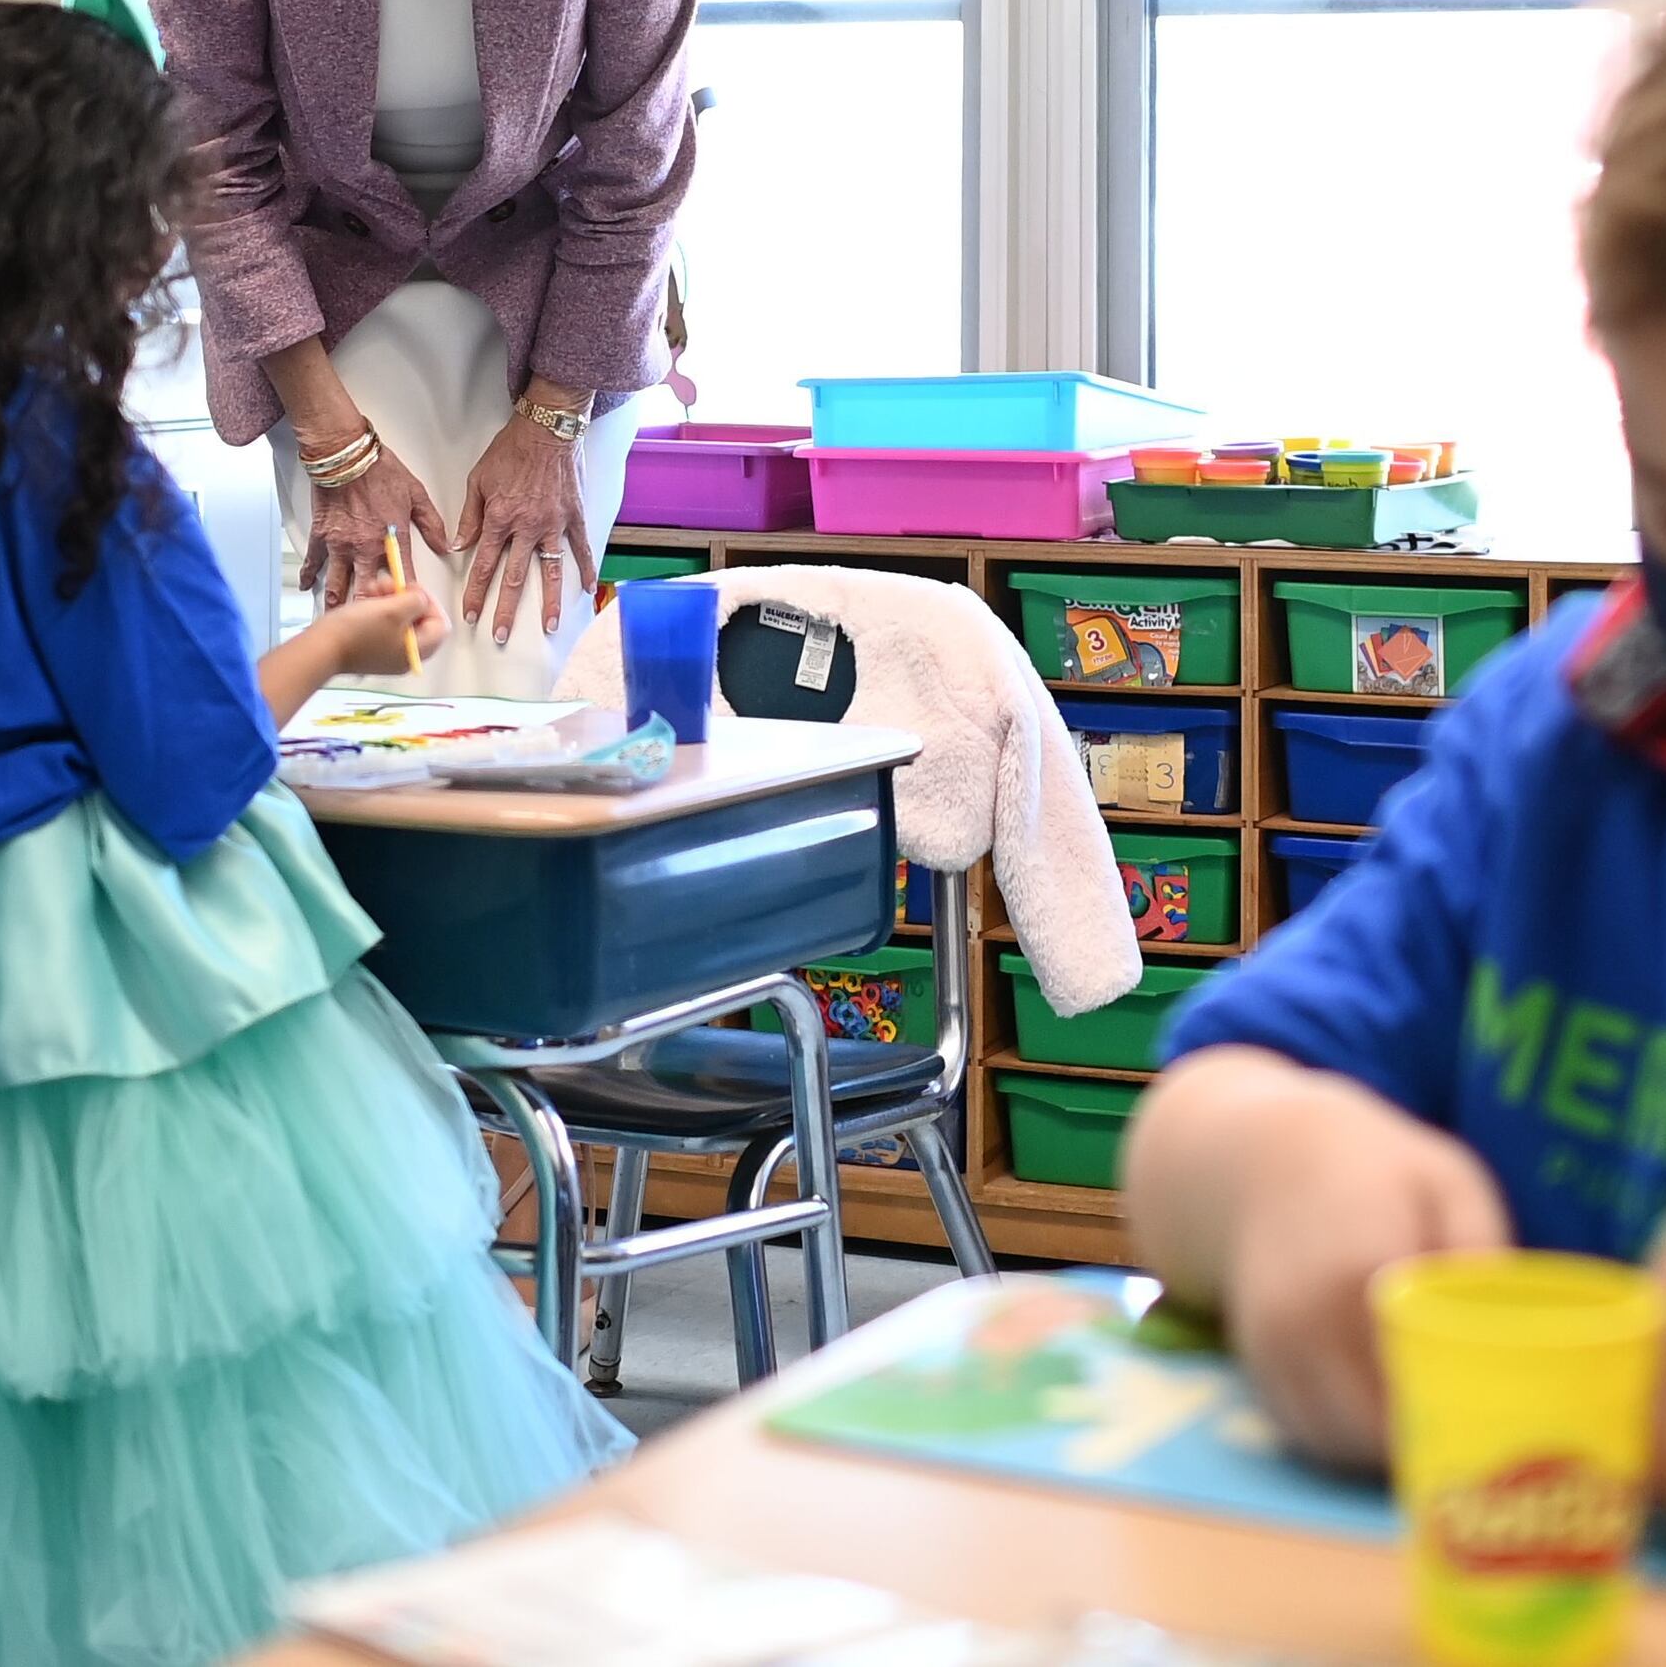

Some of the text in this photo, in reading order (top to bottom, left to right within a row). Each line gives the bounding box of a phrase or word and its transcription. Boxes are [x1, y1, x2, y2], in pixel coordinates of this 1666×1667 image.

[1130, 616, 1174, 629] Activity
[1087, 630, 1105, 651] 3
[1156, 763, 1174, 789] 3
